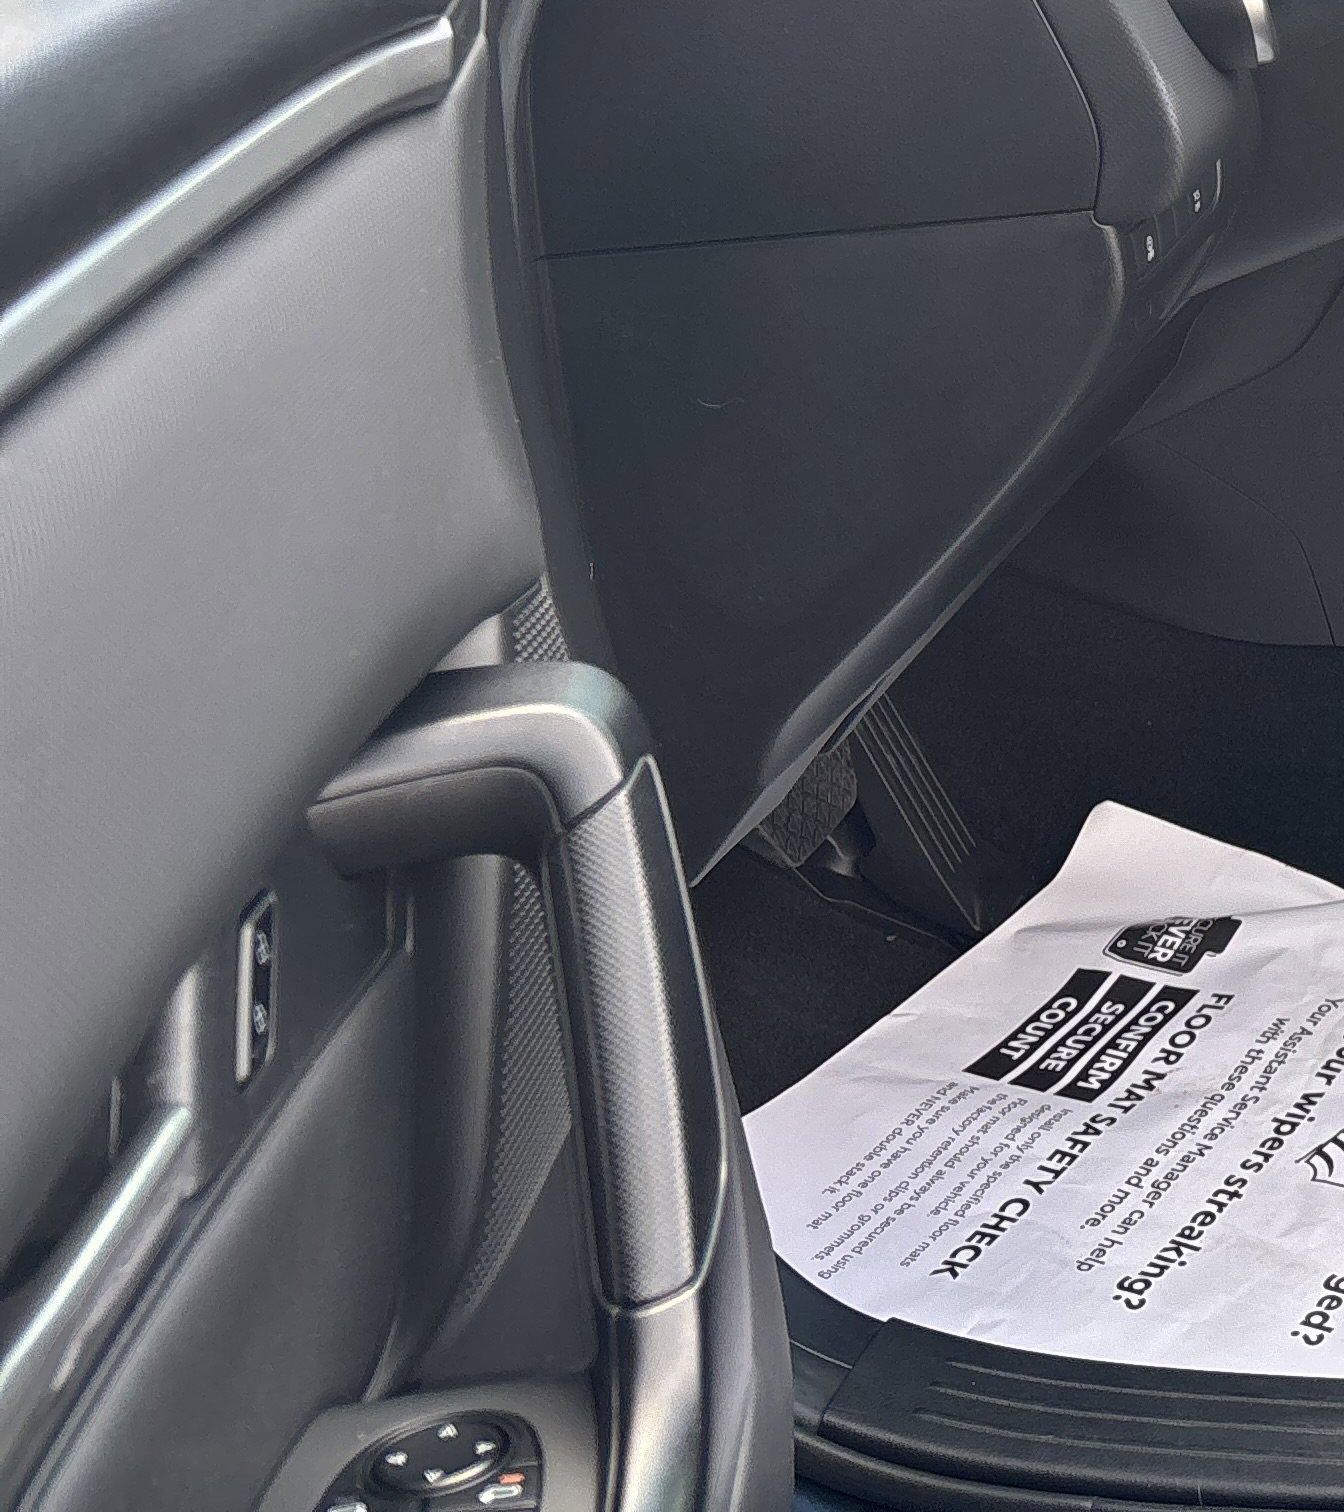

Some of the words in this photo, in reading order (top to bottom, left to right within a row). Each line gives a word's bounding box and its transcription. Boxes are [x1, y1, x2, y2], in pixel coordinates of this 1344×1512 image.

[1148, 918, 1199, 962] EVER
[1000, 996, 1078, 1061] COUNT
[1151, 993, 1235, 1065] FLOOR
[1305, 997, 1344, 1027] Your
[1039, 1001, 1125, 1072] SECURE
[1077, 1000, 1176, 1090] CONFIRM
[1255, 1017, 1290, 1043] with
[1221, 1045, 1264, 1091] these
[1250, 1026, 1313, 1093] Assistant
[1108, 1070, 1168, 1114] MAT
[900, 1094, 941, 1128] NEVER
[926, 1104, 950, 1126] sure
[951, 1102, 993, 1136] factory
[977, 1115, 1001, 1136] mat
[1155, 1092, 1226, 1156] questions
[1203, 1093, 1259, 1141] Service
[864, 1127, 903, 1161] double
[905, 1124, 930, 1146] you
[993, 1141, 1010, 1157] for
[1017, 1132, 1042, 1155] only
[1240, 1091, 1325, 1173] wipers
[880, 1145, 911, 1170] have
[910, 1136, 955, 1180] retention
[943, 1135, 981, 1169] should
[966, 1157, 993, 1180] your
[999, 1152, 1022, 1169] the
[1023, 1113, 1117, 1195] SAFETY
[833, 1161, 866, 1187] stack
[857, 1169, 882, 1189] one
[913, 1168, 946, 1202] always
[1125, 1157, 1159, 1189] and
[1145, 1142, 1213, 1208] Manager
[831, 1189, 862, 1214] floor
[883, 1180, 910, 1203] clips
[894, 1201, 916, 1216] be
[926, 1184, 963, 1218] vehicle.
[953, 1170, 1002, 1219] specified
[1079, 1188, 1131, 1229] more.
[806, 1210, 832, 1230] mat
[870, 1203, 884, 1215] or
[1111, 1209, 1144, 1235] can
[811, 1214, 871, 1261] grommets.
[851, 1215, 896, 1255] secured
[929, 1197, 1030, 1280] CHECK
[931, 1218, 960, 1242] floor
[1112, 1174, 1248, 1310] streaking?
[818, 1253, 850, 1280] using
[900, 1241, 930, 1267] mats
[1076, 1237, 1123, 1272] help
